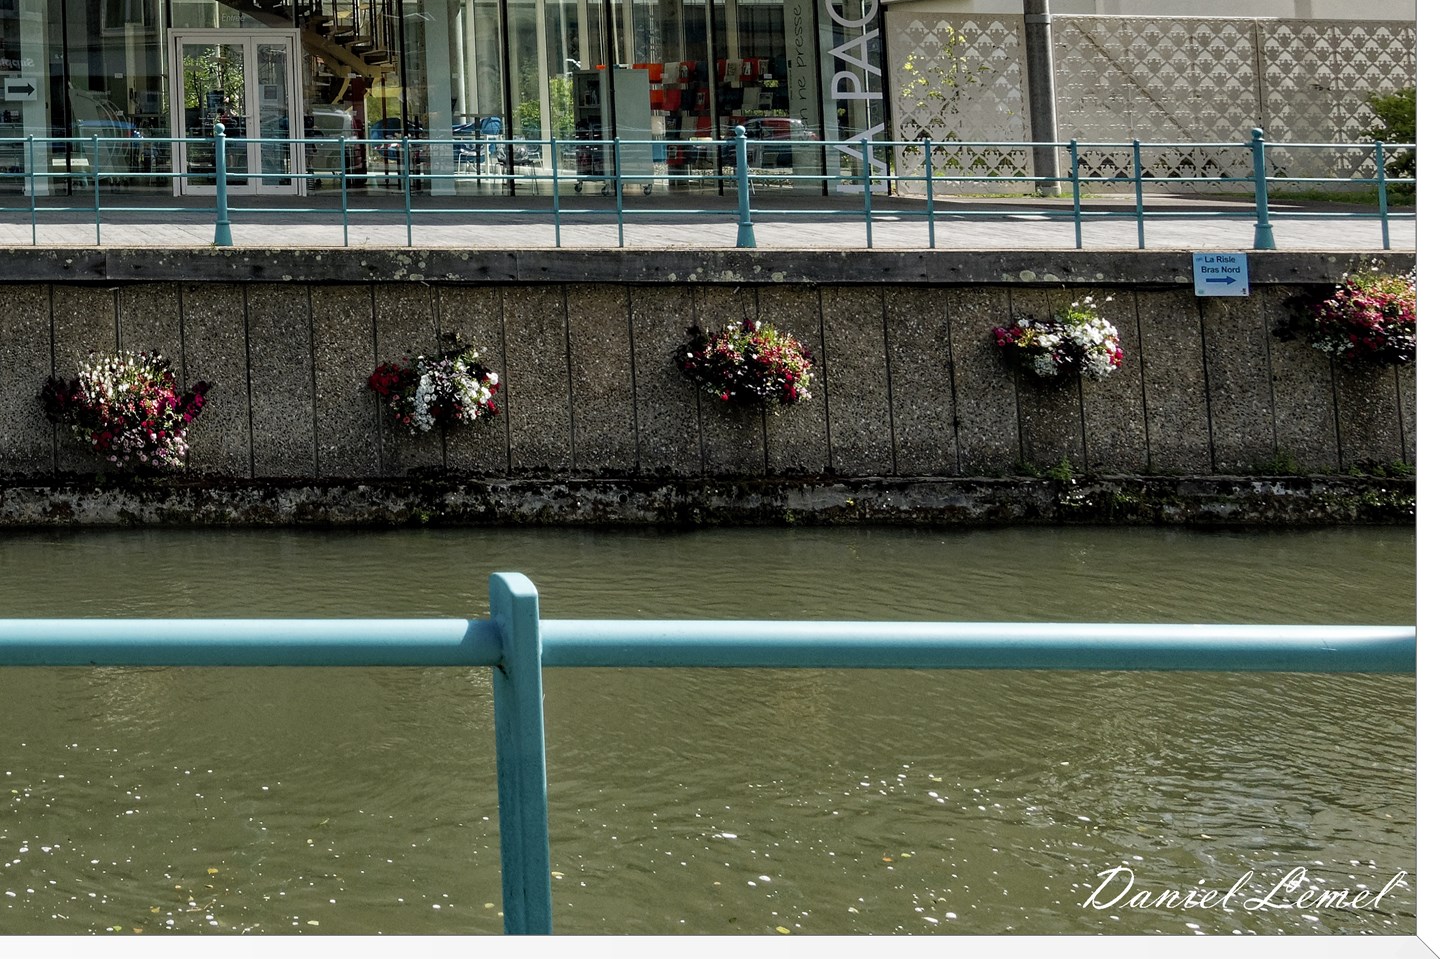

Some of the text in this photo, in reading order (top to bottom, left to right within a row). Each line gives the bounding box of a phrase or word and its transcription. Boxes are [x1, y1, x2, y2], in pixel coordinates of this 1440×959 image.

[792, 4, 807, 68] presse
[796, 76, 807, 100] ne
[832, 122, 888, 193] LA
[1201, 265, 1241, 274] Bras Nord
[1204, 255, 1215, 263] La
[1216, 255, 1236, 263] Risle
